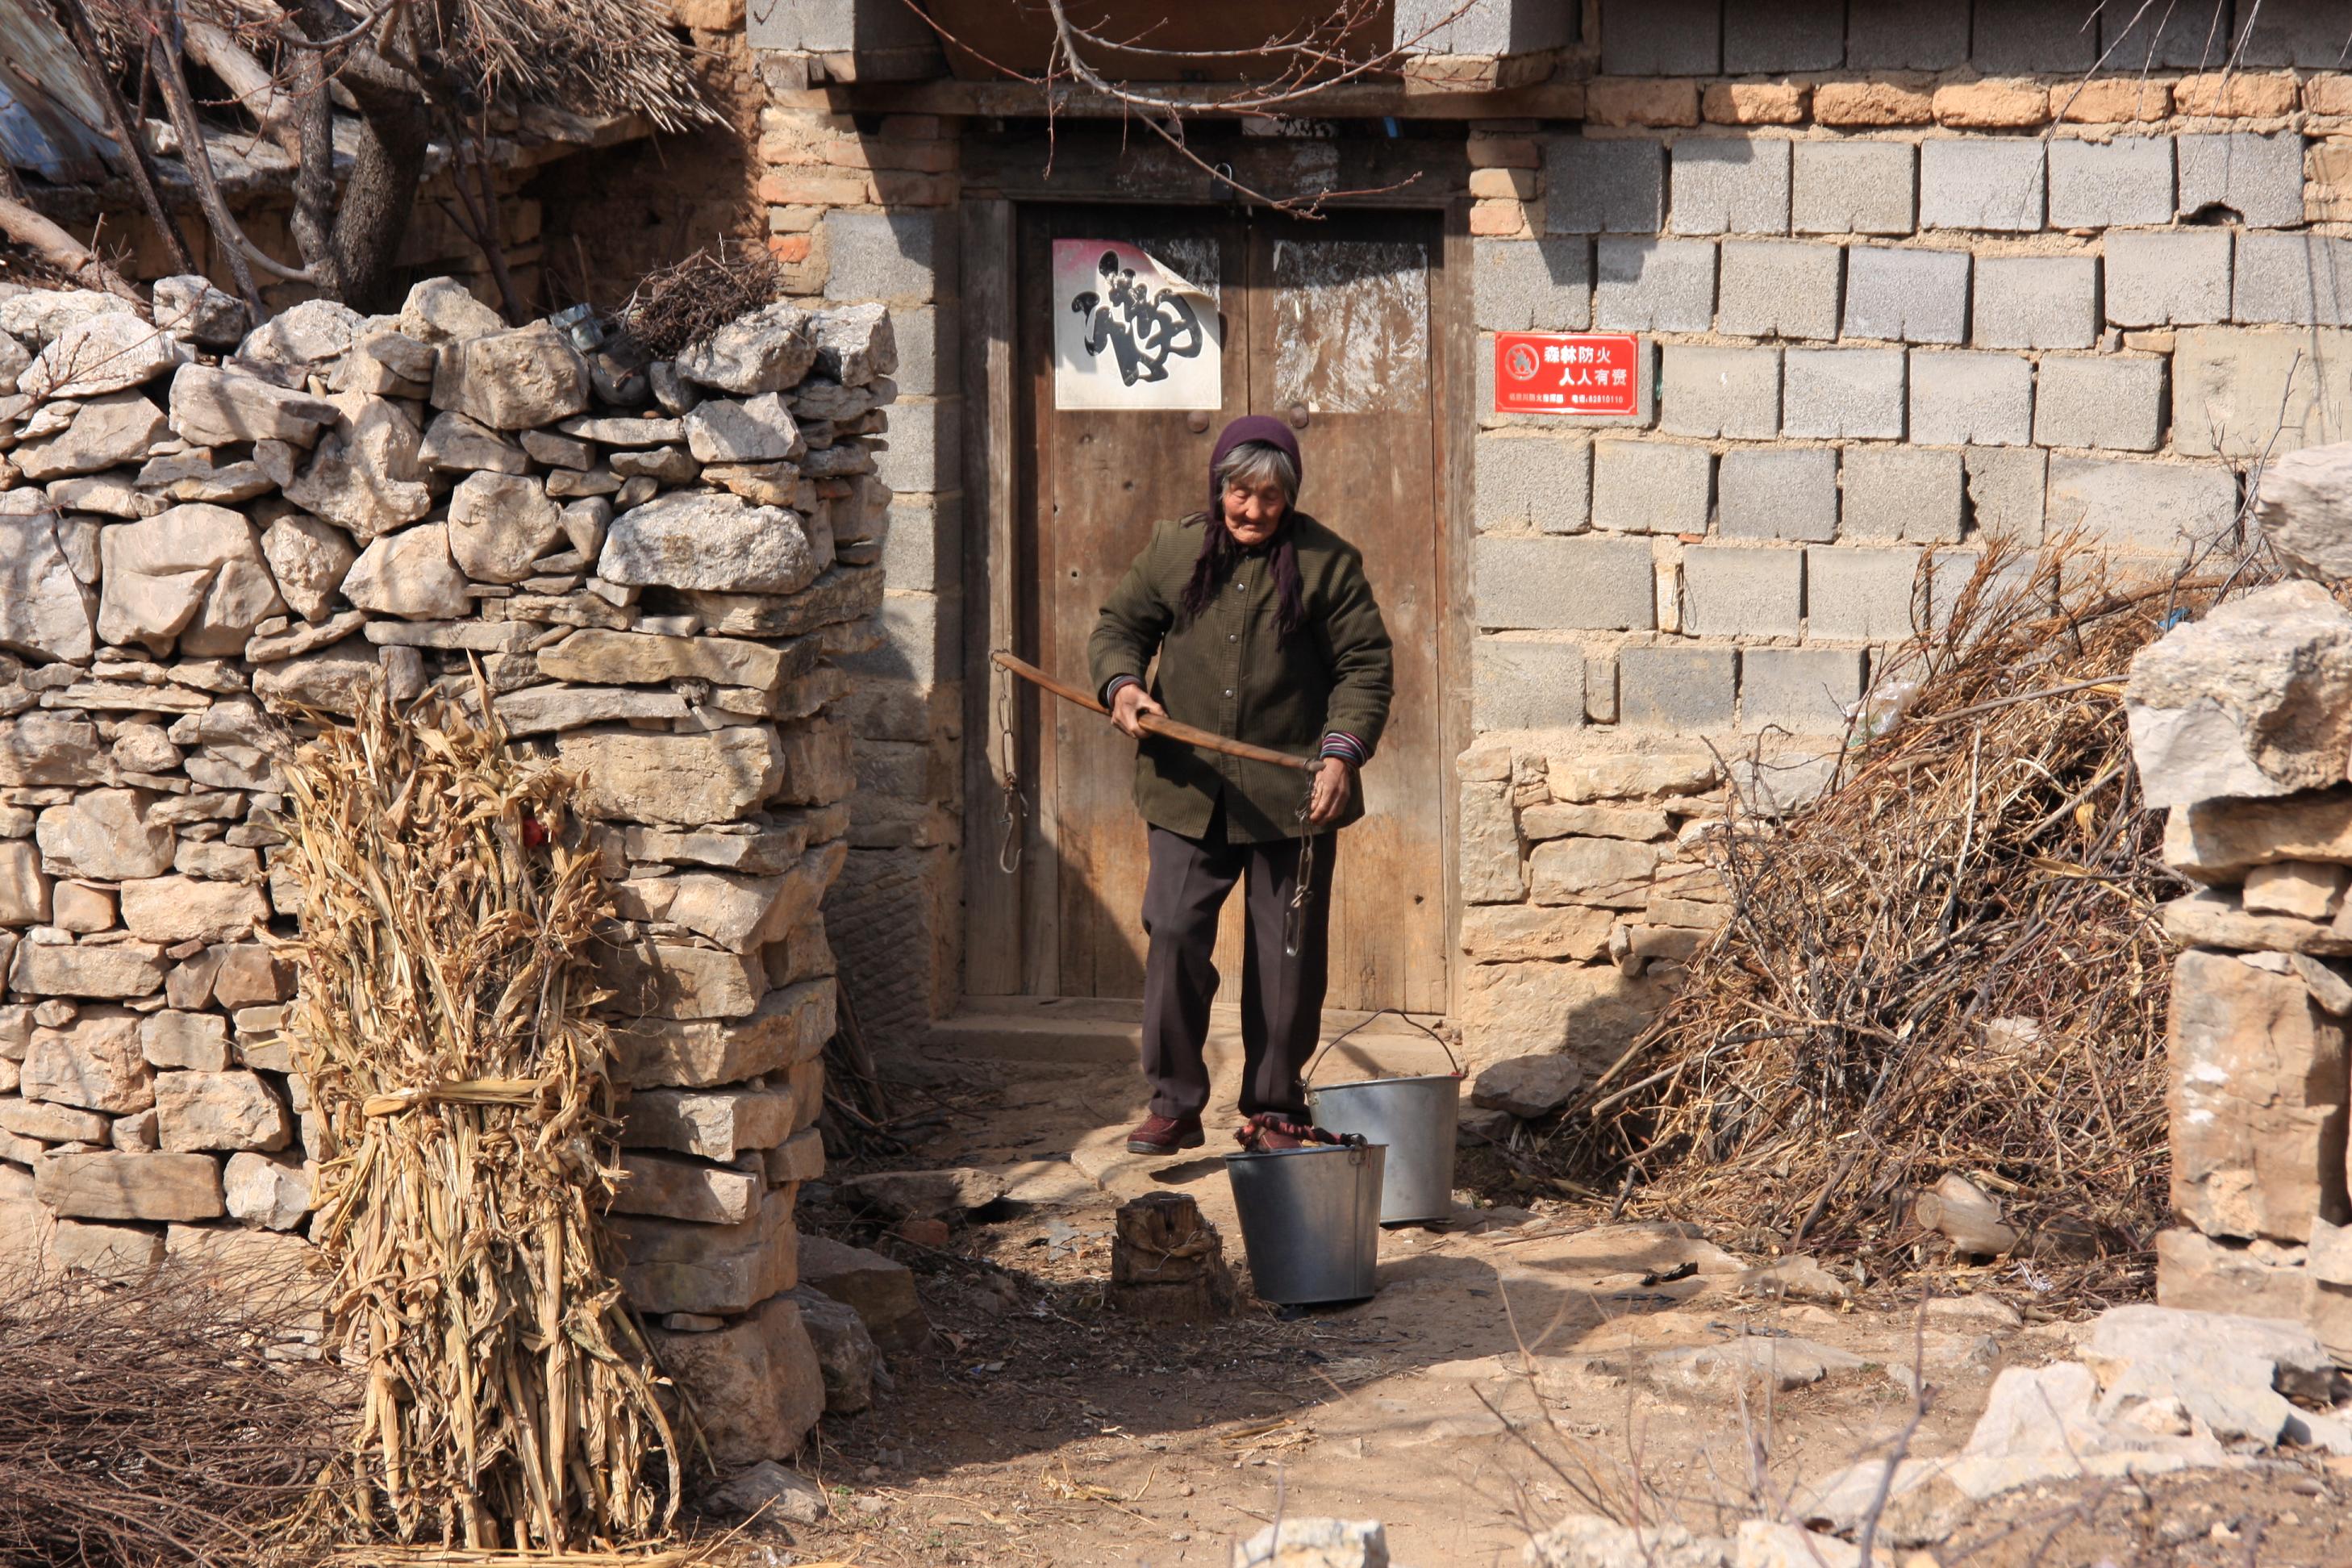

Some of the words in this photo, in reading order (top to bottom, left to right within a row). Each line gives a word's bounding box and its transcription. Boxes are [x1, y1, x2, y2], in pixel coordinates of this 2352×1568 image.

[1544, 345, 1611, 363] 森林防火
[1558, 367, 1626, 386] 人人有责
